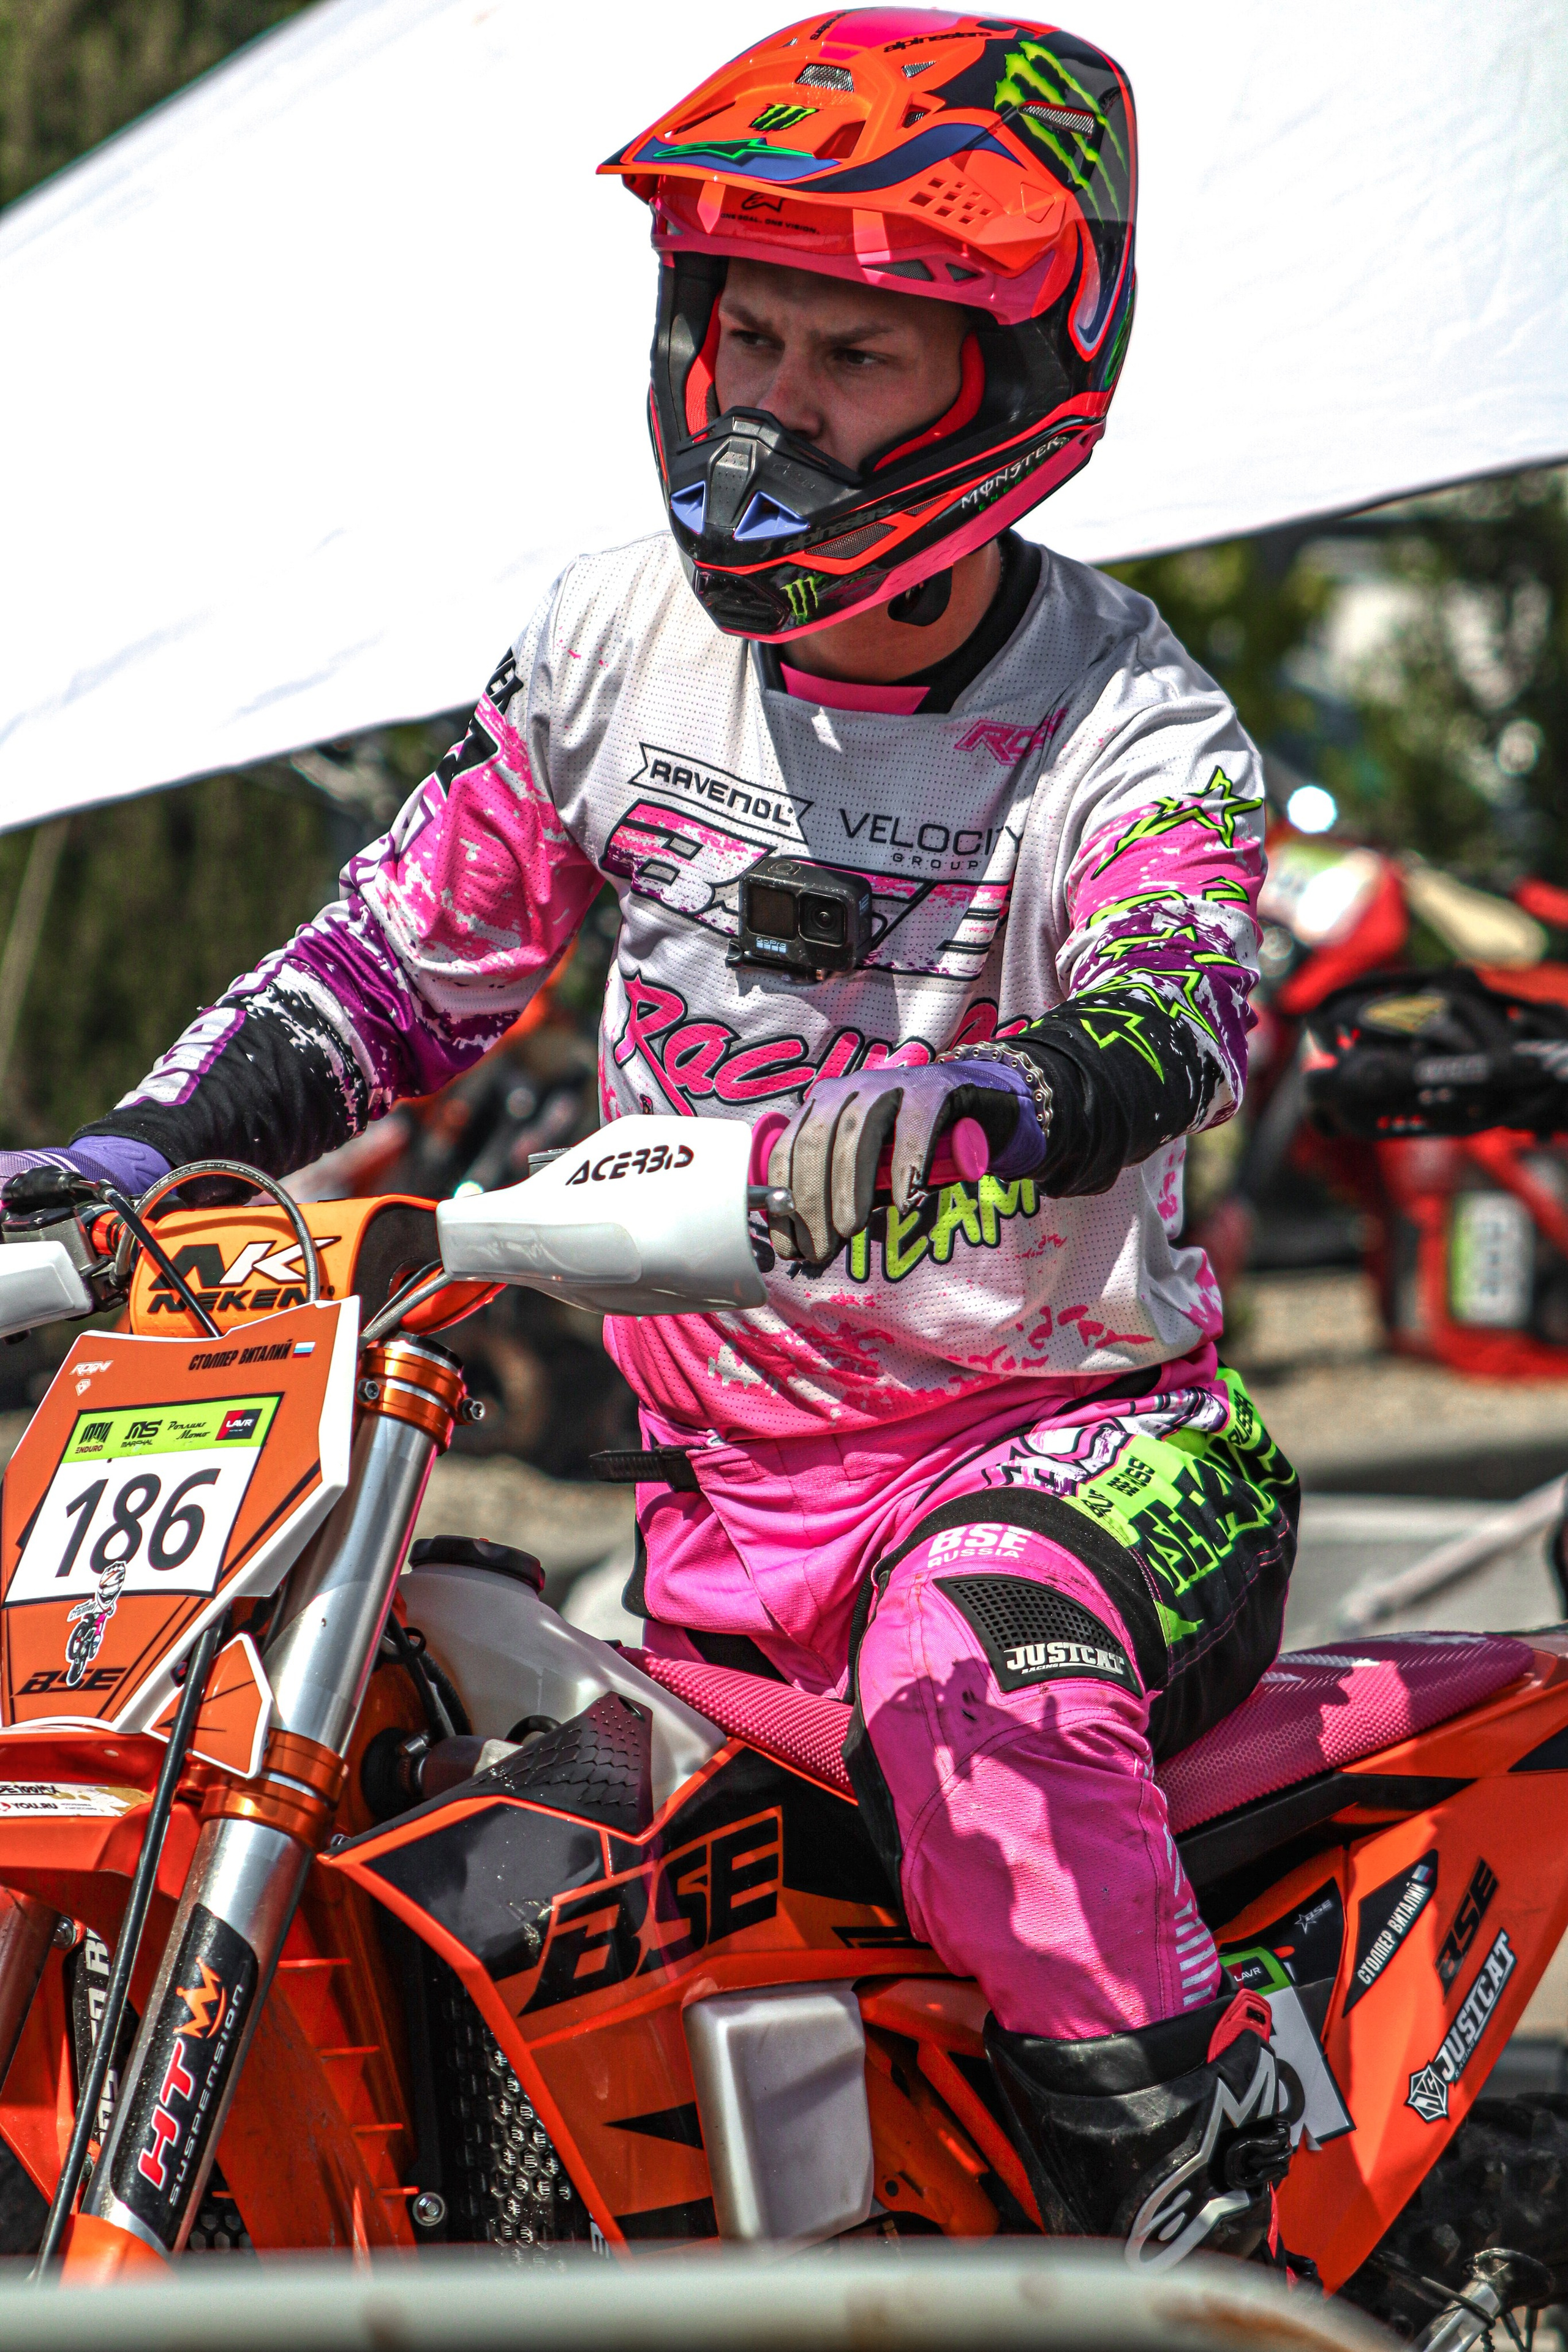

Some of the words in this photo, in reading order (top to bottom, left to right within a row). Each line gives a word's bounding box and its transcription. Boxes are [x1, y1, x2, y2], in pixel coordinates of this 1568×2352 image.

[765, 218, 783, 227] ONE
[961, 435, 1060, 509] MONSTER
[839, 808, 1025, 856] VELOCIY
[892, 852, 979, 870] GROUP
[756, 937, 787, 949] GoPro
[187, 1349, 239, 1371] СТОЛПЕР
[238, 1338, 293, 1365] ВИТАЛИЙ
[225, 1418, 255, 1428] LAVR
[74, 1444, 104, 1454] ENDURO
[55, 1468, 222, 1578] 186
[927, 1523, 1033, 1558] BSE
[927, 1548, 1020, 1569] RUSSIA
[1003, 1642, 1125, 1675] JUSTCAT
[1021, 1662, 1059, 1675] RACING
[518, 1813, 780, 2017] BSE
[1305, 1899, 1332, 1921] BSE
[1357, 1931, 1395, 1985] СТОЛПЕР
[1388, 1882, 1429, 1944] ВИТАЛИЙ
[1234, 1967, 1261, 1982] LAVR
[1434, 1931, 1515, 2081] JUSTCAT
[168, 1983, 244, 2206] SUSPENSION
